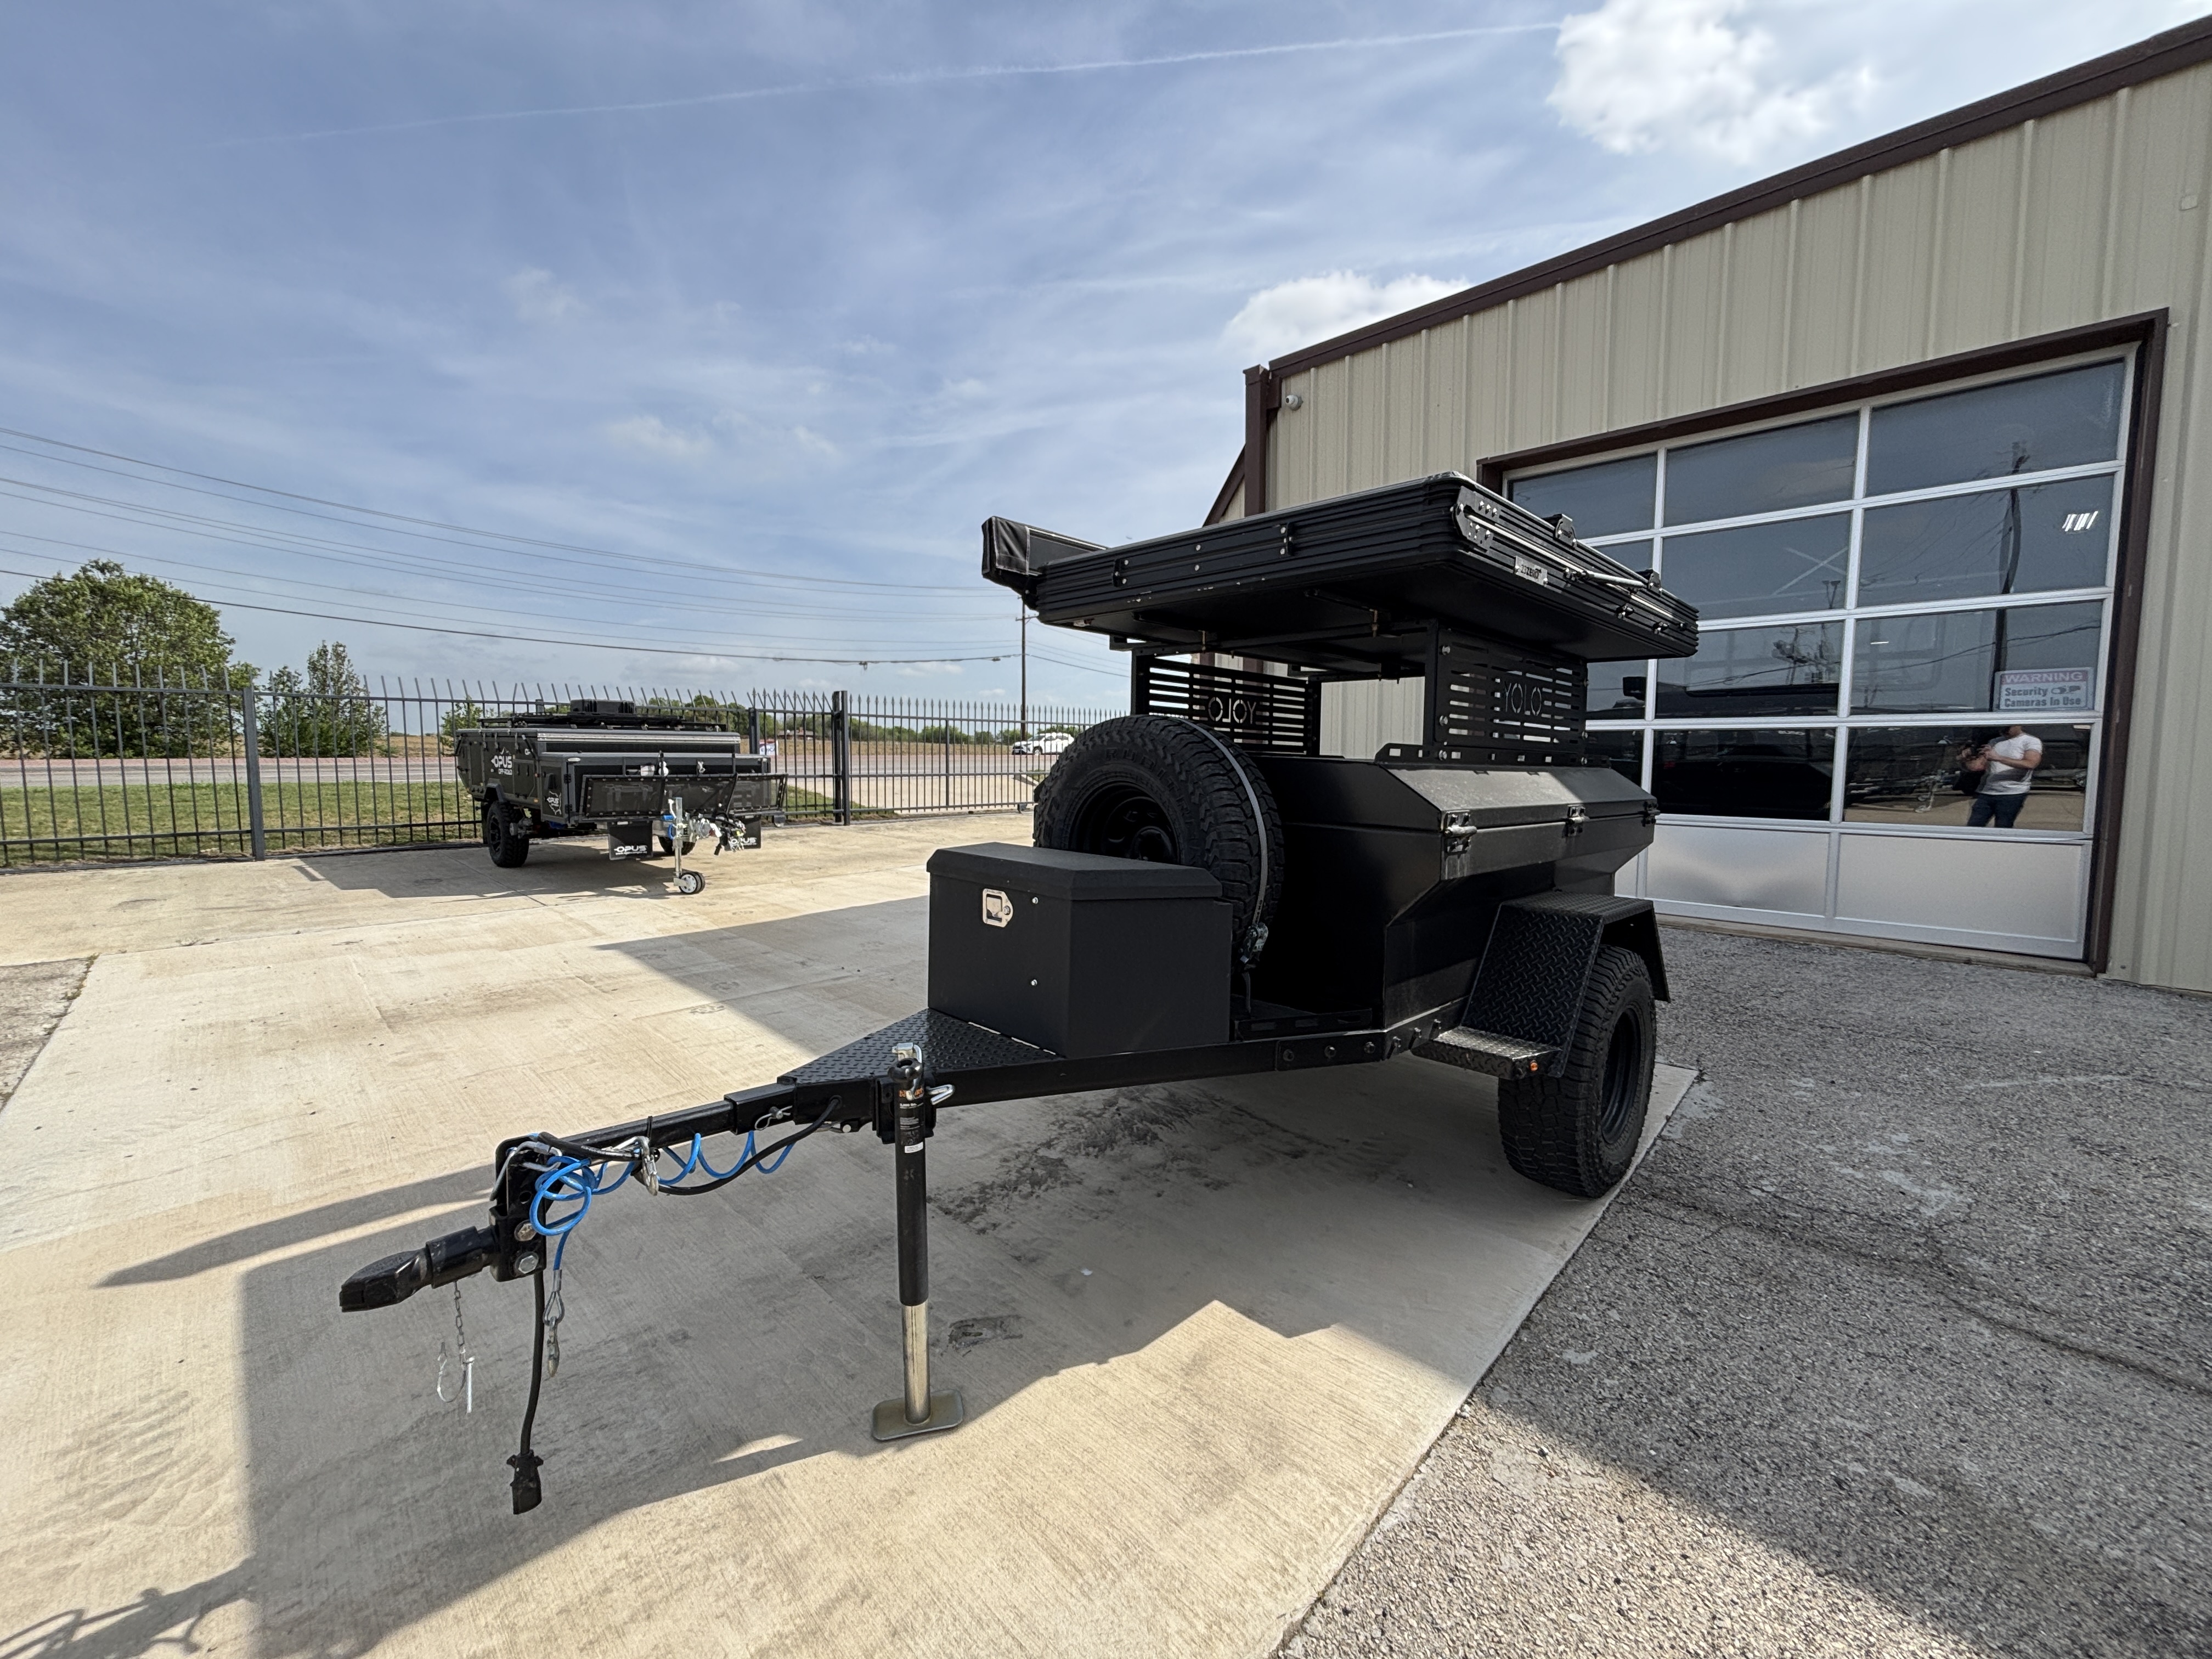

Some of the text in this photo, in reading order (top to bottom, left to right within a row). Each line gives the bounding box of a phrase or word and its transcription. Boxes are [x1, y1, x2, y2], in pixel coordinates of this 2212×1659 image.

[2005, 672, 2083, 683] WARNING
[2005, 687, 2048, 697] Security
[1504, 681, 1542, 716] YOLO
[2005, 696, 2081, 707] Cameras In Use
[492, 755, 512, 769] OPUS
